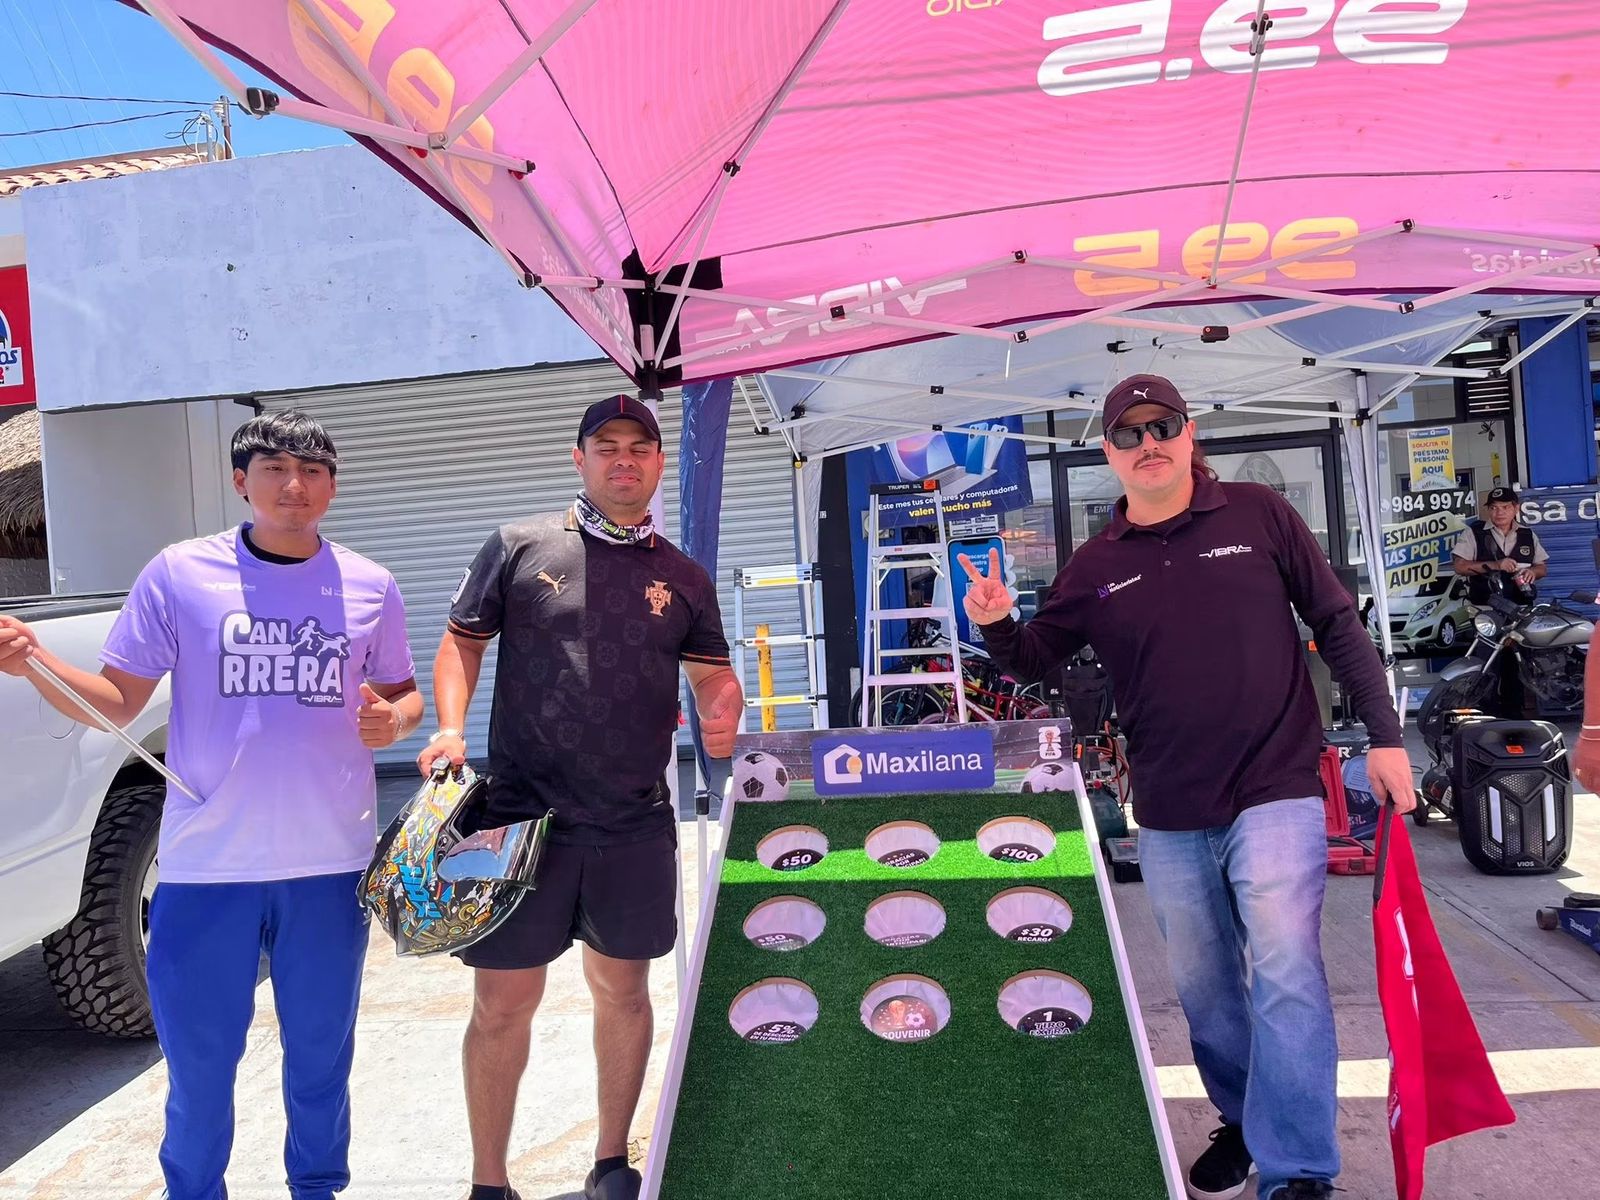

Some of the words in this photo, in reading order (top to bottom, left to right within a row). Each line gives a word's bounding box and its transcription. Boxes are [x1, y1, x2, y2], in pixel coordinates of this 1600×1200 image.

[1414, 455, 1449, 463] PERSONAL
[1422, 462, 1443, 474] AQUÍ
[878, 503, 894, 511] Este
[896, 501, 911, 509] mes
[912, 499, 924, 507] tus
[960, 493, 965, 501] y
[966, 484, 1018, 498] computadoras
[1392, 495, 1425, 513] 984
[908, 507, 934, 518] valen
[972, 499, 992, 509] más
[1383, 516, 1448, 547] ESTAMOS
[1199, 545, 1252, 558] VIBRA
[1410, 540, 1440, 560] POR
[1389, 562, 1433, 589] AUTO
[223, 612, 293, 655] CAN
[223, 655, 342, 694] RRERA
[302, 694, 342, 703] VIBRA
[867, 749, 983, 776] Maxilana
[782, 853, 812, 867] $50
[1001, 847, 1039, 862] $100
[757, 934, 786, 943] $50
[1020, 927, 1054, 938] $30
[1043, 1011, 1053, 1022] 1
[768, 1024, 797, 1034] 5%
[1034, 1020, 1067, 1030] TIRO
[882, 1028, 931, 1040] SOUVENIR
